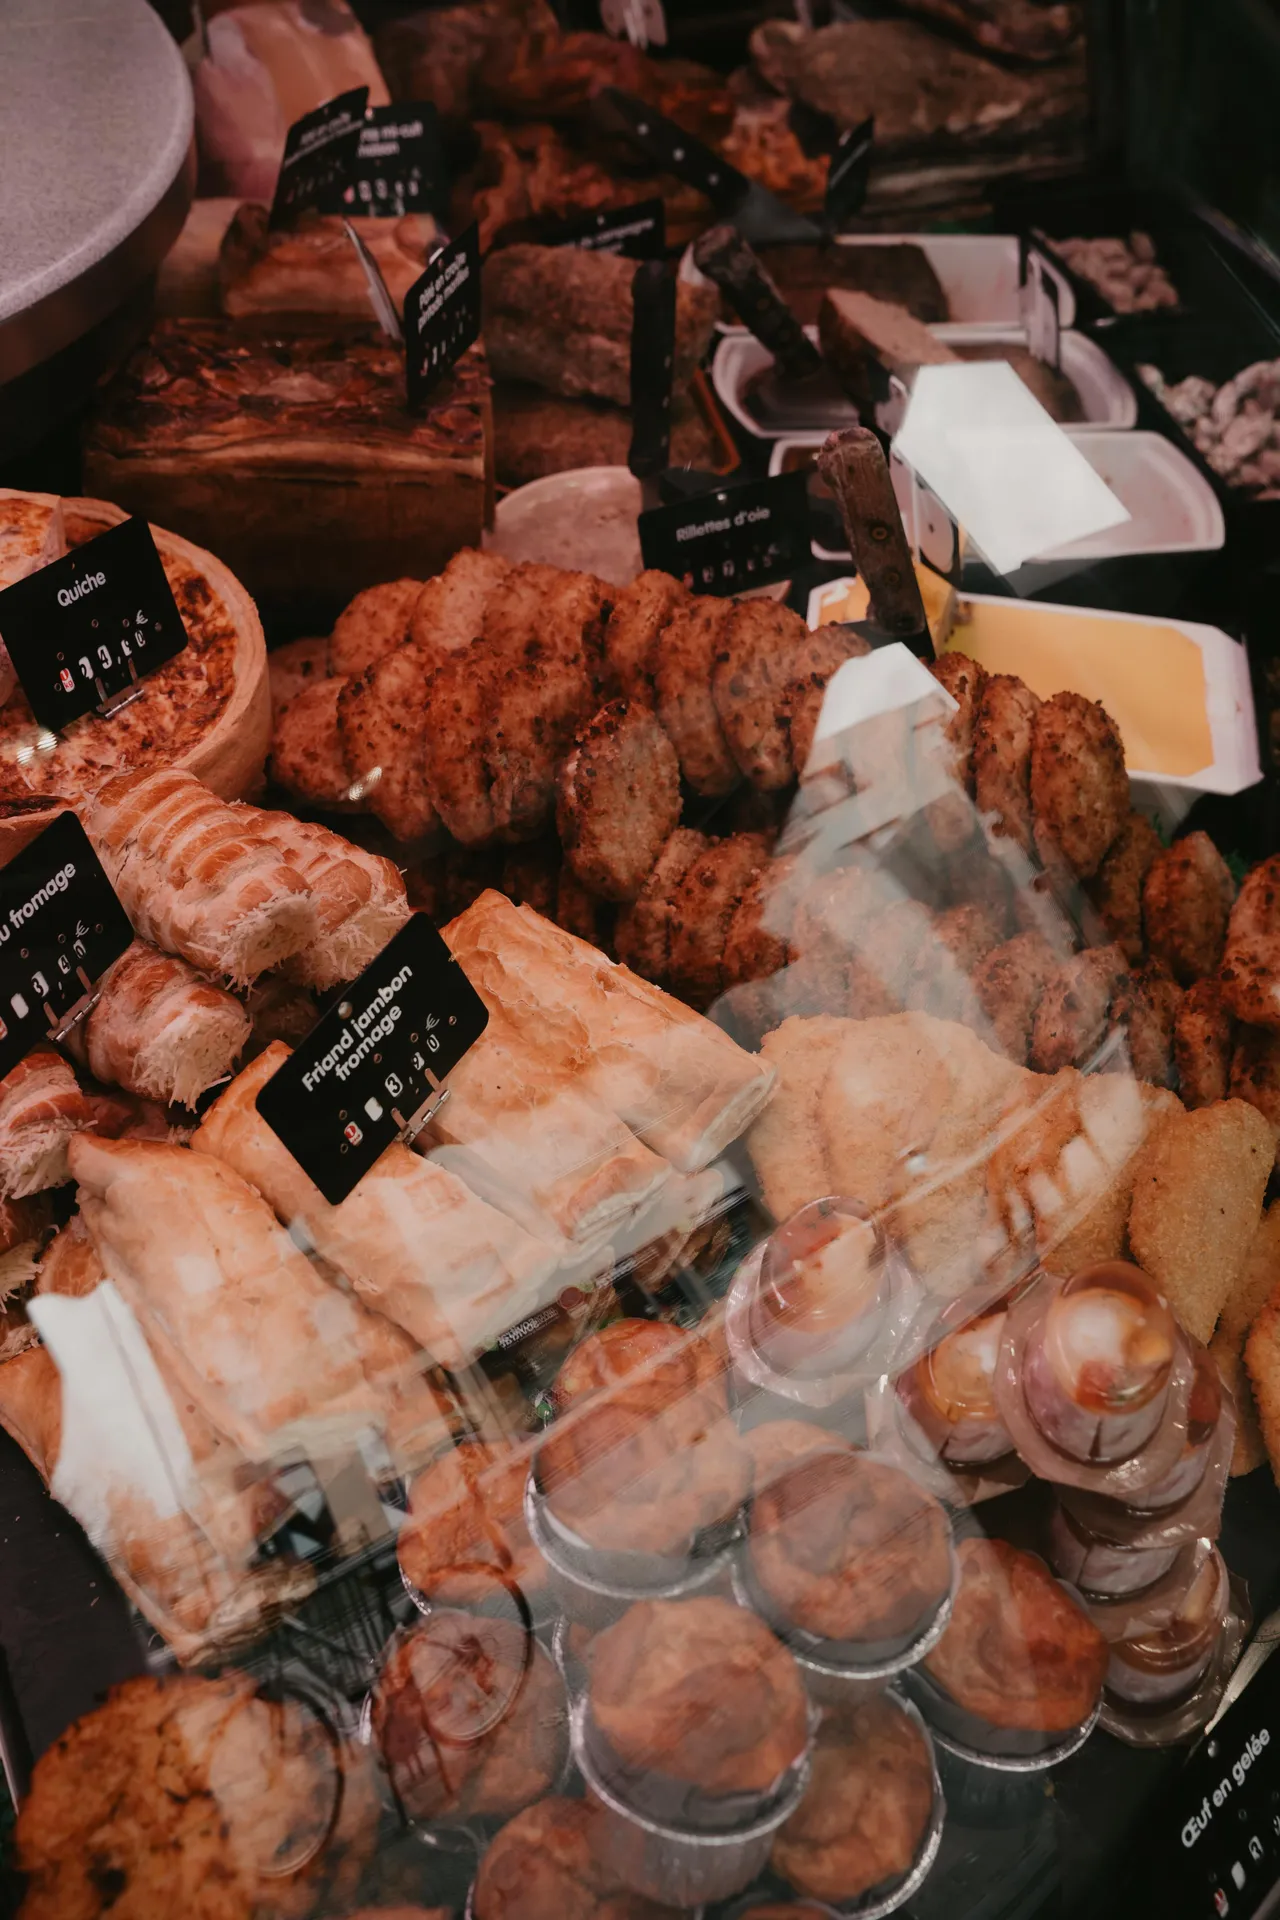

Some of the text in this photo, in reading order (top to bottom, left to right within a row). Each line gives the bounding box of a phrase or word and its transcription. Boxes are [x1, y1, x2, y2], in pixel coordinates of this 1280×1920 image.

[675, 506, 771, 541] Rillettes d'oie
[57, 570, 107, 607] Quiche
[135, 609, 149, 624] €
[9, 862, 77, 930] fromage
[74, 919, 91, 938] €
[301, 964, 413, 1093] Friand jambon
[426, 1013, 440, 1031] €
[335, 1004, 403, 1082] fromage
[1180, 1728, 1271, 1849] Œuf en gelée
